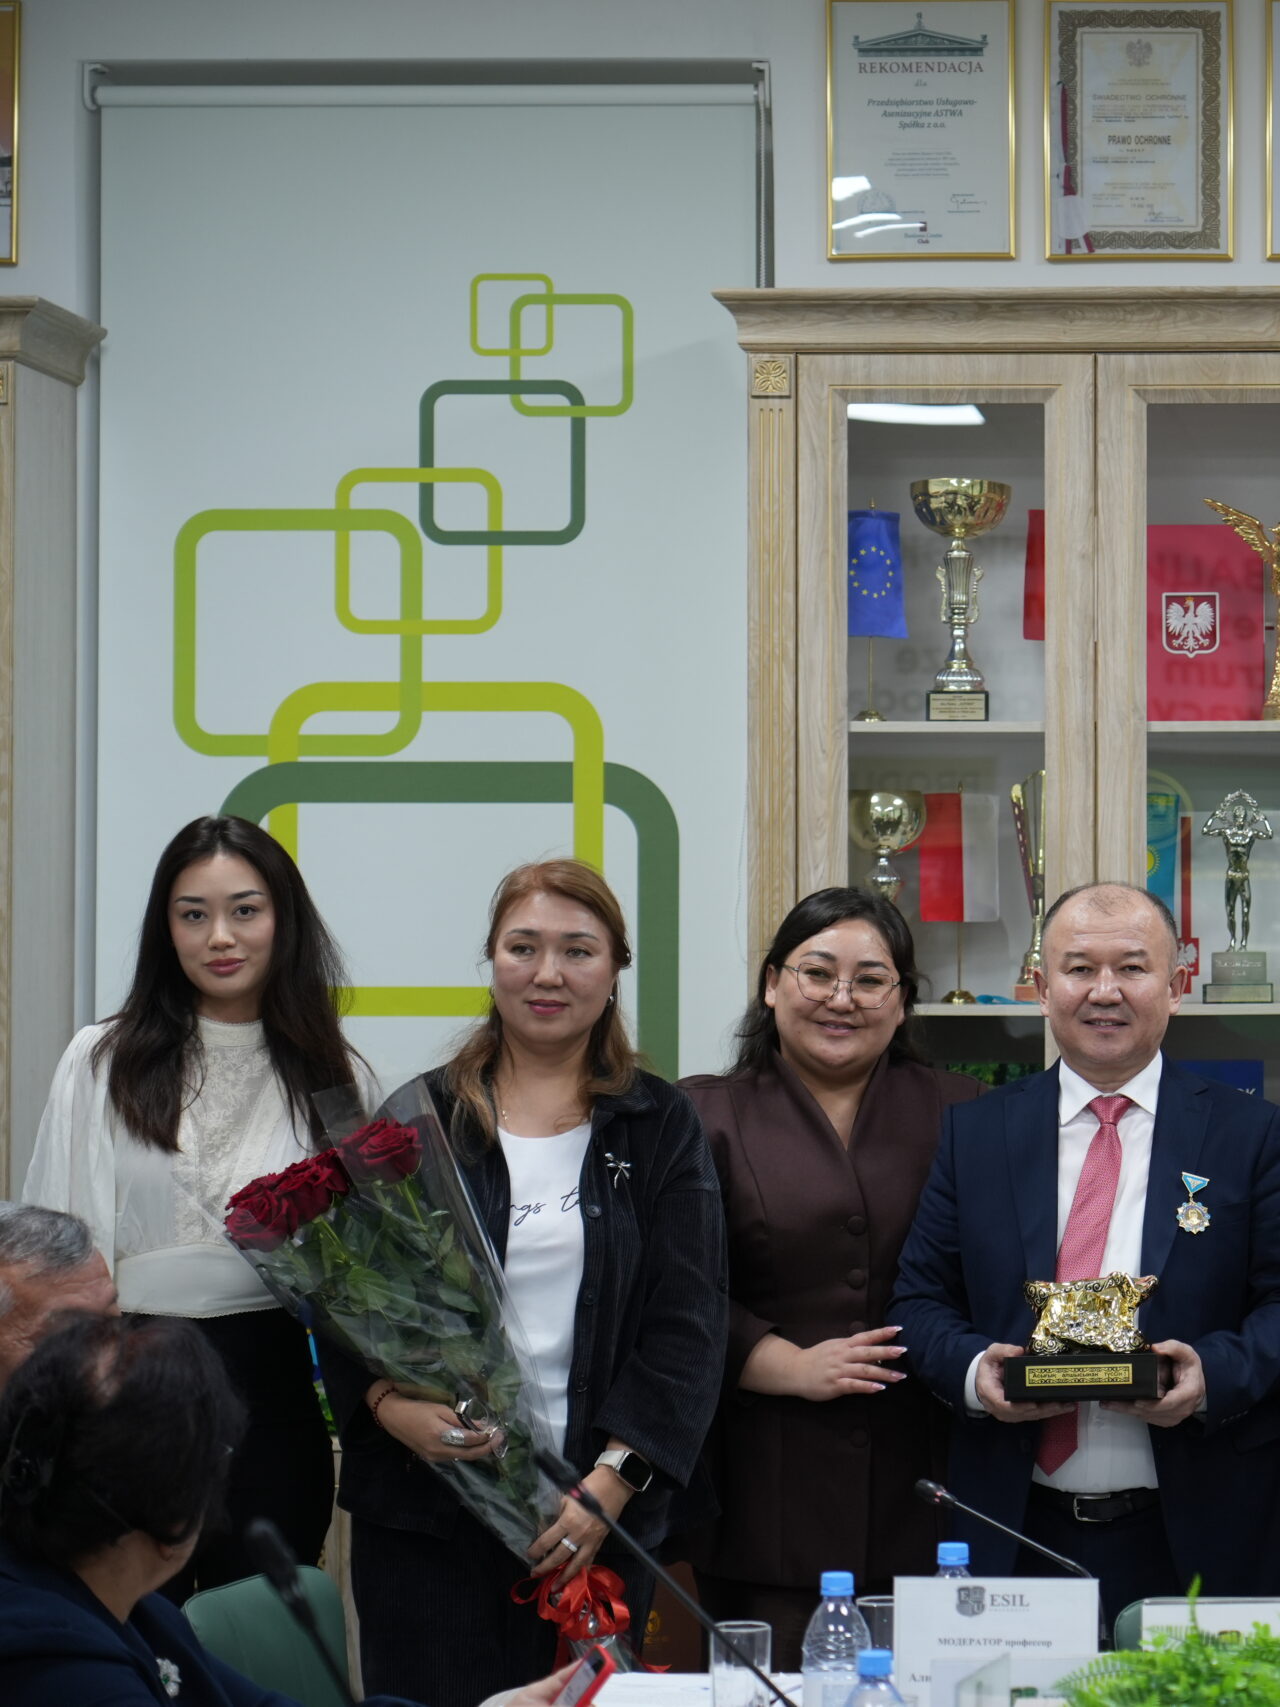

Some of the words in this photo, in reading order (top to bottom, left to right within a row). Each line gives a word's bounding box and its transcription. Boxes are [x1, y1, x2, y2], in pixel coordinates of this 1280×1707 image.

[858, 61, 984, 74] REKOMENDACJA
[934, 109, 963, 118] ASTWA
[1108, 135, 1132, 145] PRAWO
[1134, 135, 1172, 145] OCHRONNE
[990, 1594, 1030, 1607] ESIL
[938, 1638, 1003, 1647] МОДЕРАТОР
[1005, 1638, 1052, 1648] профессор
